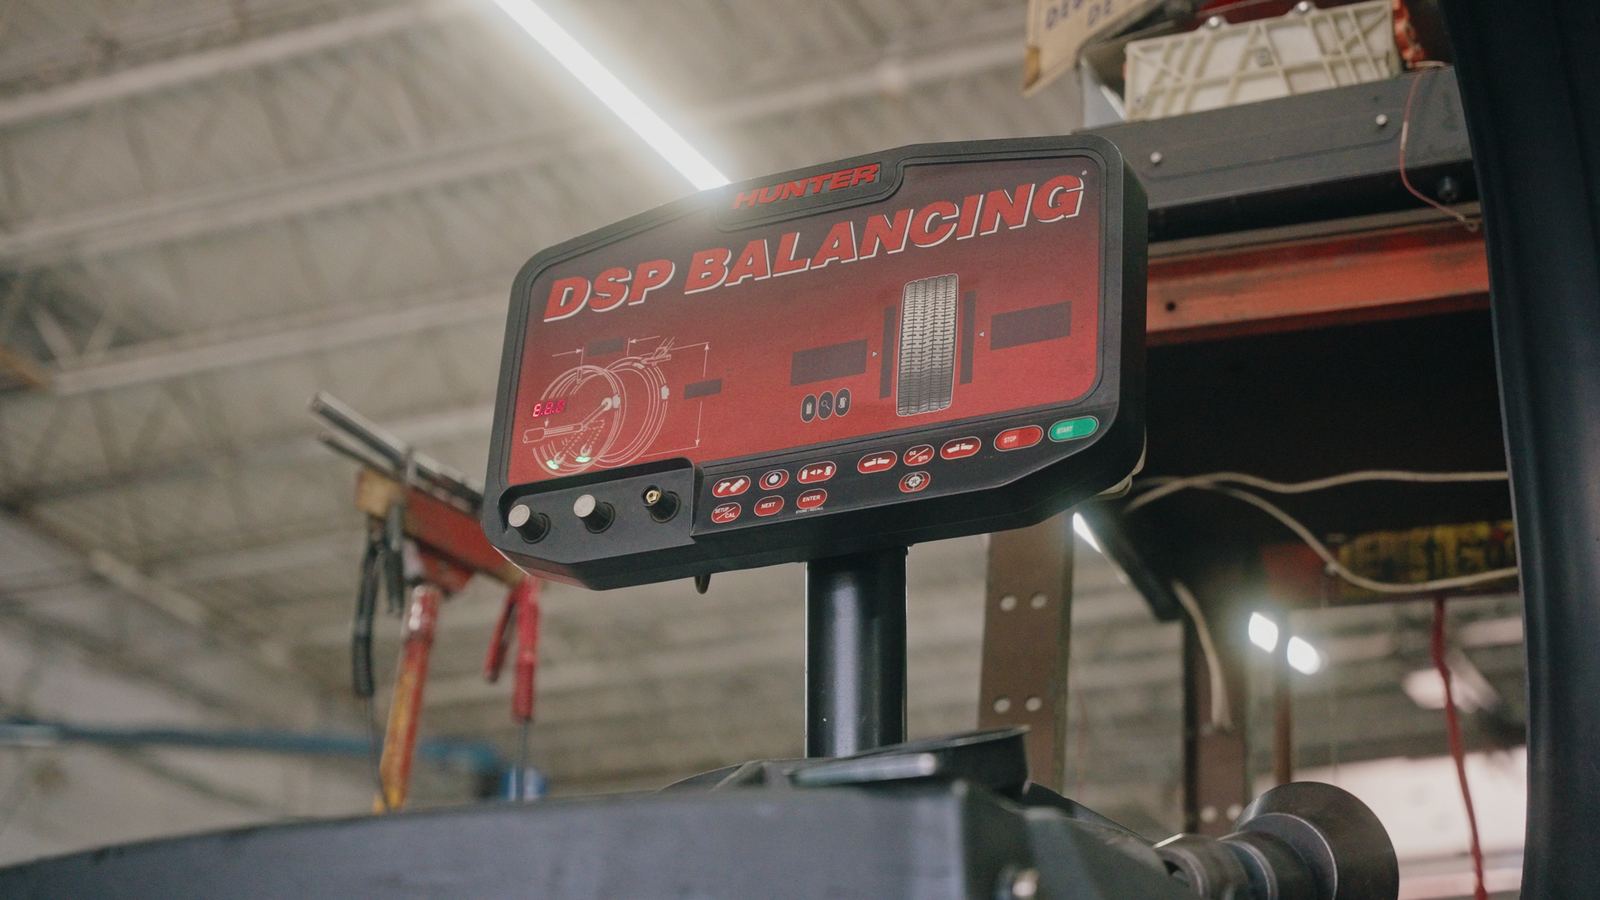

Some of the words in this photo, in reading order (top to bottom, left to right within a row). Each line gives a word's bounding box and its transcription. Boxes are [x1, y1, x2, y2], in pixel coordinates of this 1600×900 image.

[732, 163, 878, 209] HUNTER
[544, 258, 675, 323] DSP
[684, 174, 1085, 294] BALANCING
[1003, 435, 1018, 444] STOP
[802, 494, 821, 502] ENTER
[761, 501, 777, 509] NEXT
[714, 506, 729, 514] SETUP
